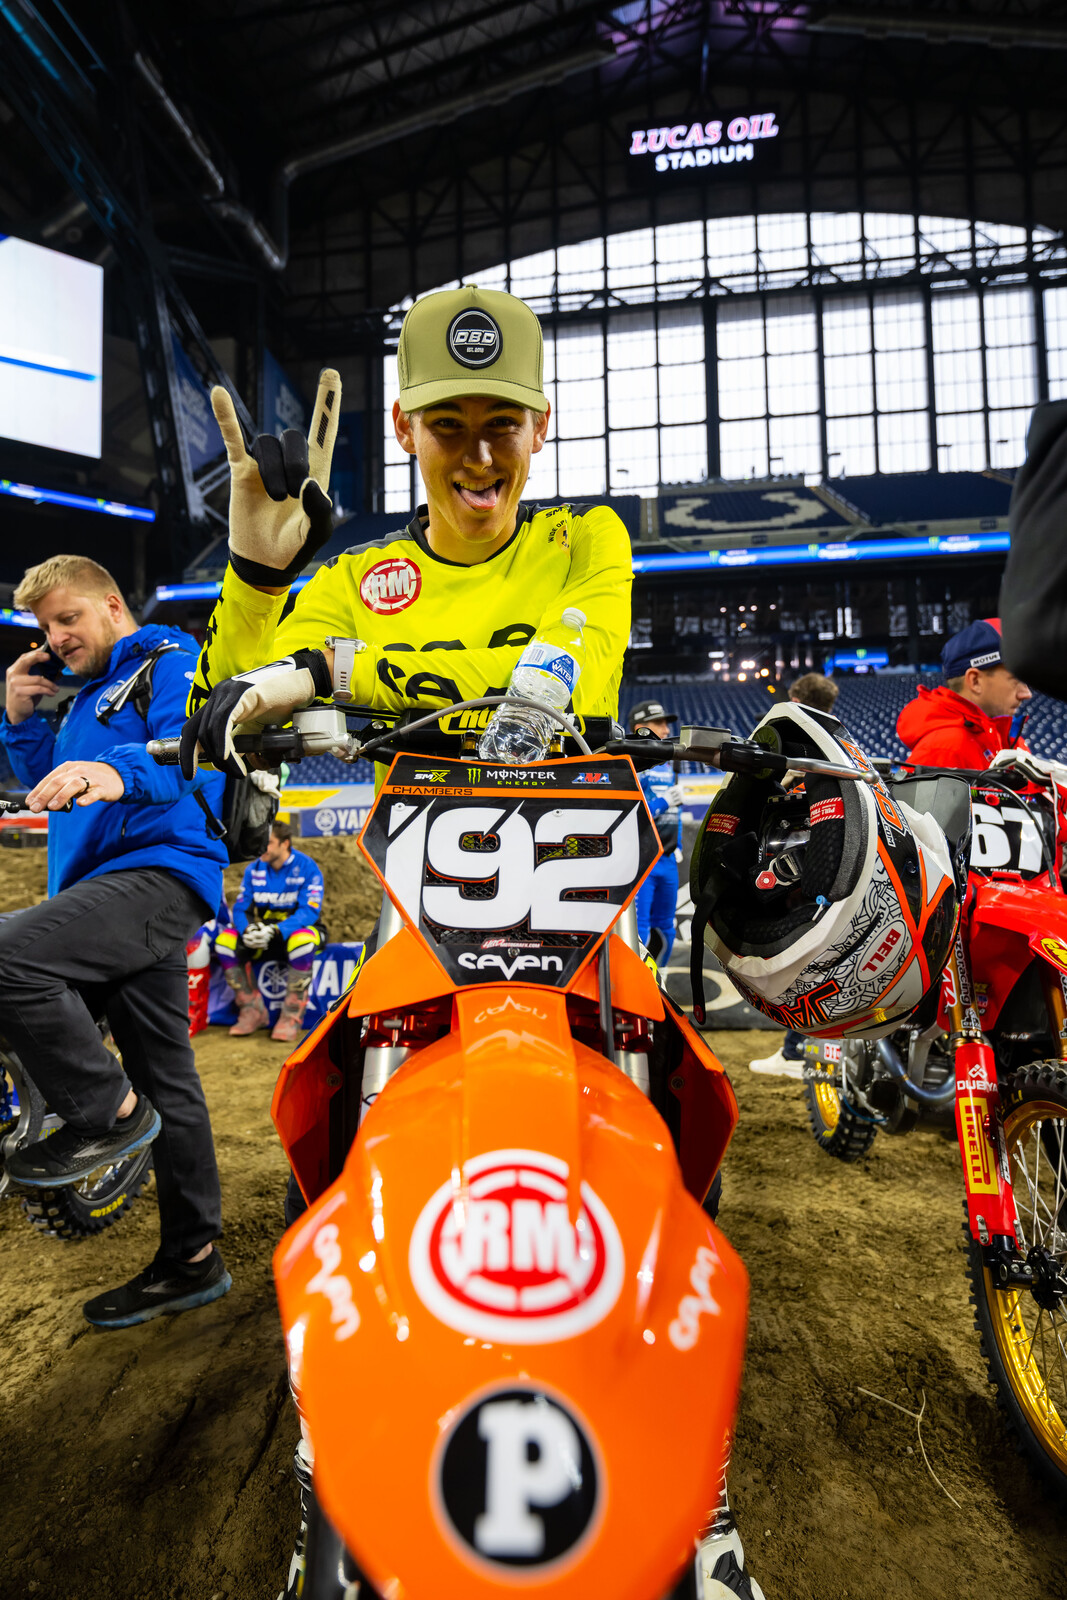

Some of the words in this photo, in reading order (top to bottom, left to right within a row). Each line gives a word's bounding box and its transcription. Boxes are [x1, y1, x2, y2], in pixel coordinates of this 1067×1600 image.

[630, 120, 722, 154] LUCAS
[727, 113, 779, 142] OIL
[655, 143, 754, 172] STADIUM
[453, 329, 497, 346] DBD
[552, 662, 572, 683] WATER
[392, 786, 473, 796] CHAMBERS
[414, 770, 450, 782] SMX
[486, 769, 556, 780] MONSTER
[571, 772, 611, 784] AMA
[970, 803, 1044, 873] 67
[387, 798, 641, 932] 192
[861, 928, 902, 973] BELL
[957, 1079, 999, 1093] DUBYA
[964, 1105, 991, 1186] PIRELLI
[474, 1400, 582, 1558] P
